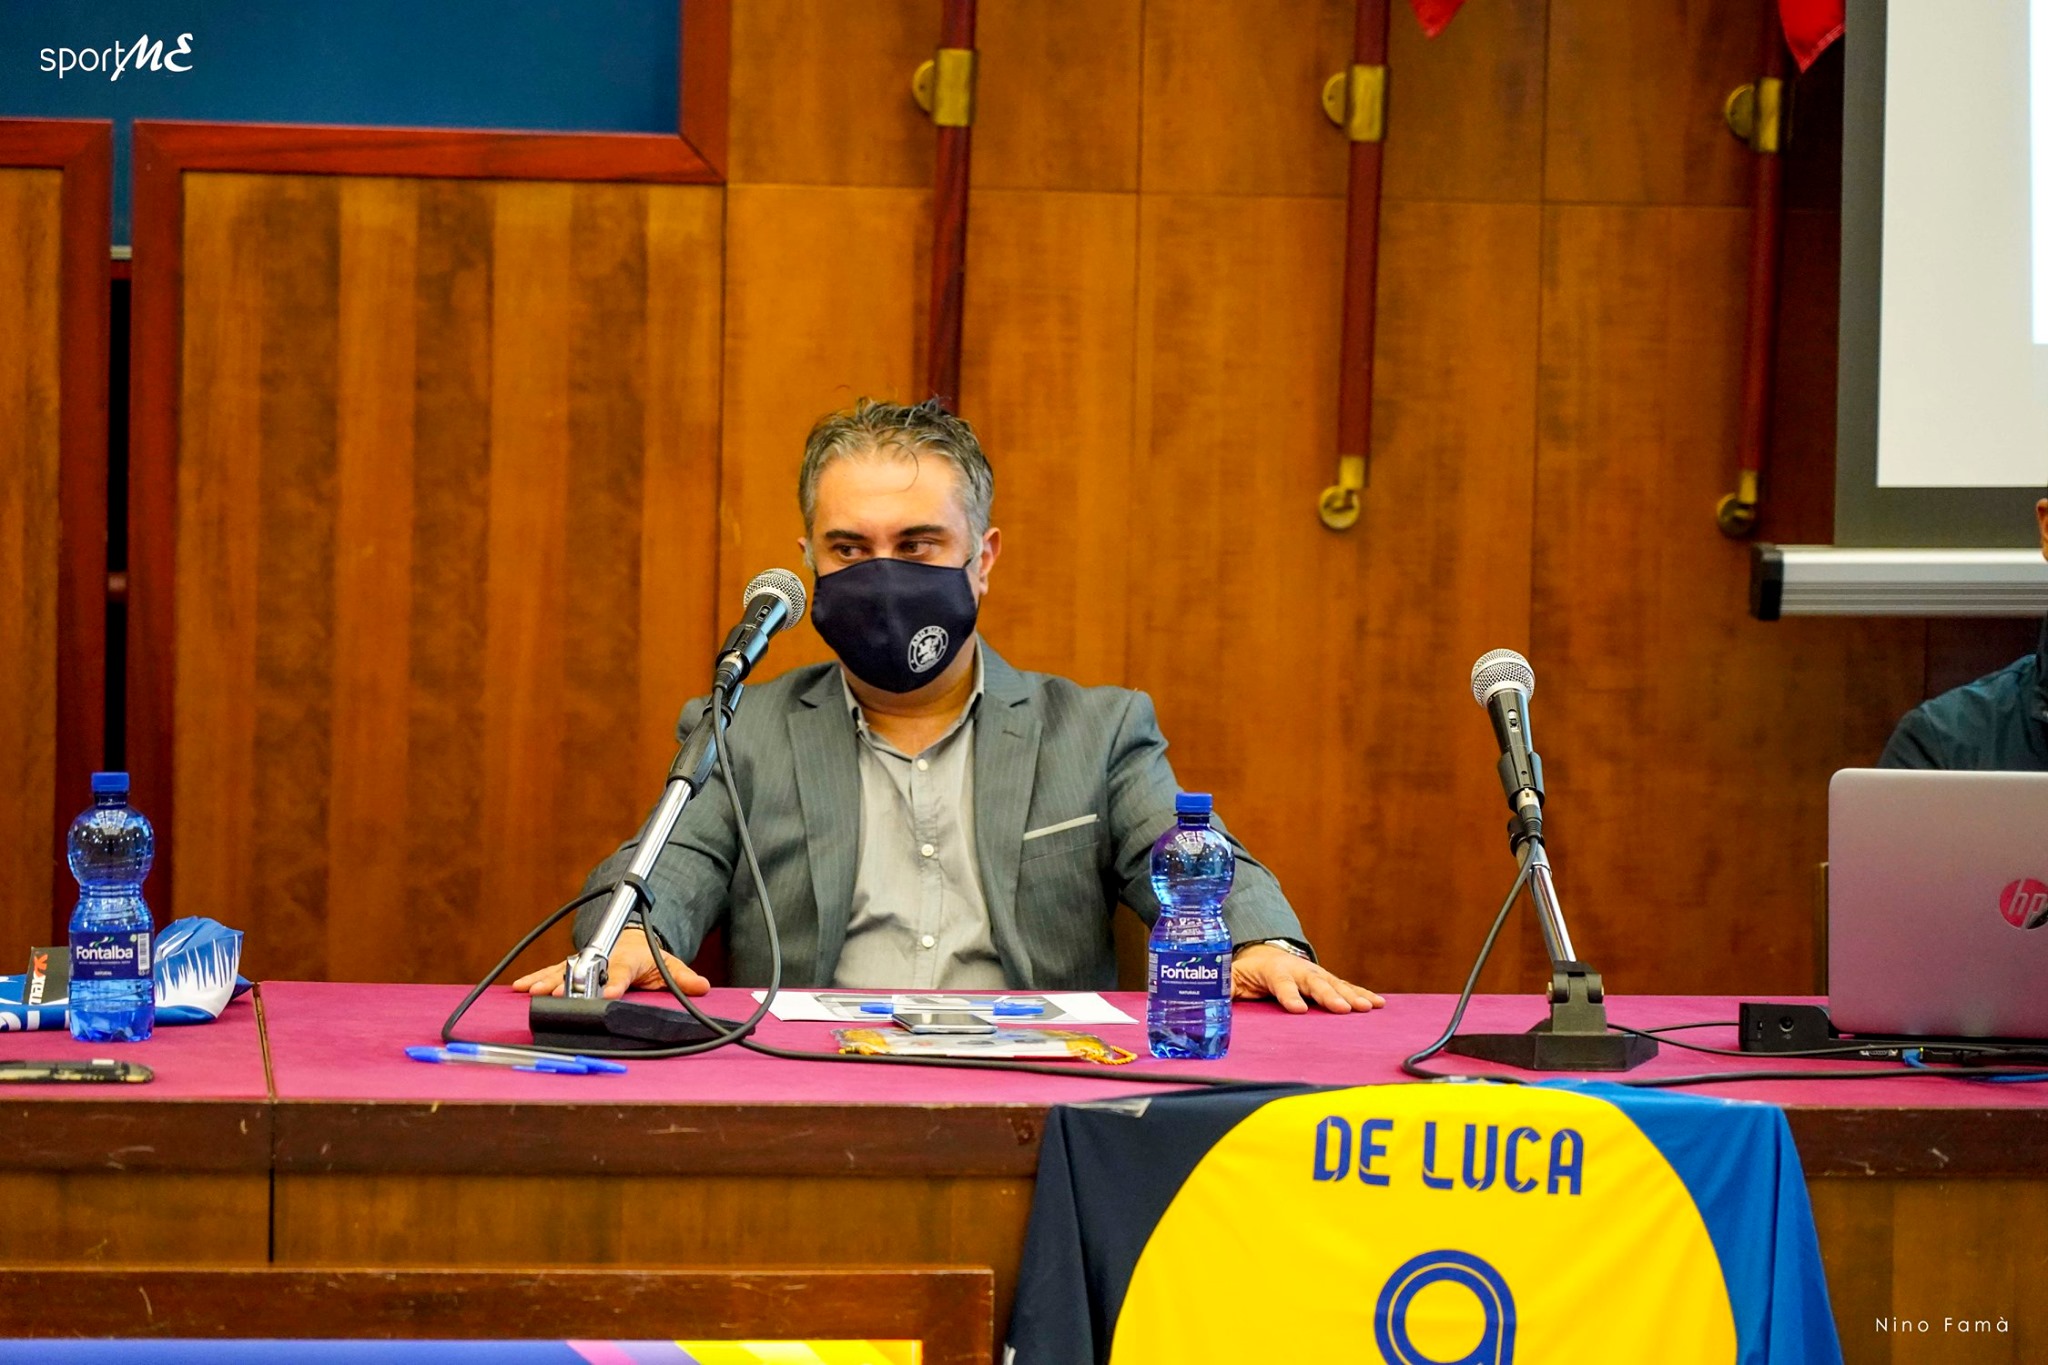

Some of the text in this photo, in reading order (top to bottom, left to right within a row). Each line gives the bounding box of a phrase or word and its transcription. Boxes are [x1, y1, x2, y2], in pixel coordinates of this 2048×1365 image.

[2009, 878, 2048, 930] hp
[76, 945, 134, 960] Fontalba
[1160, 965, 1219, 979] Fontalba
[1312, 1115, 1584, 1196] DE LUCA
[1374, 1249, 1517, 1365] 9
